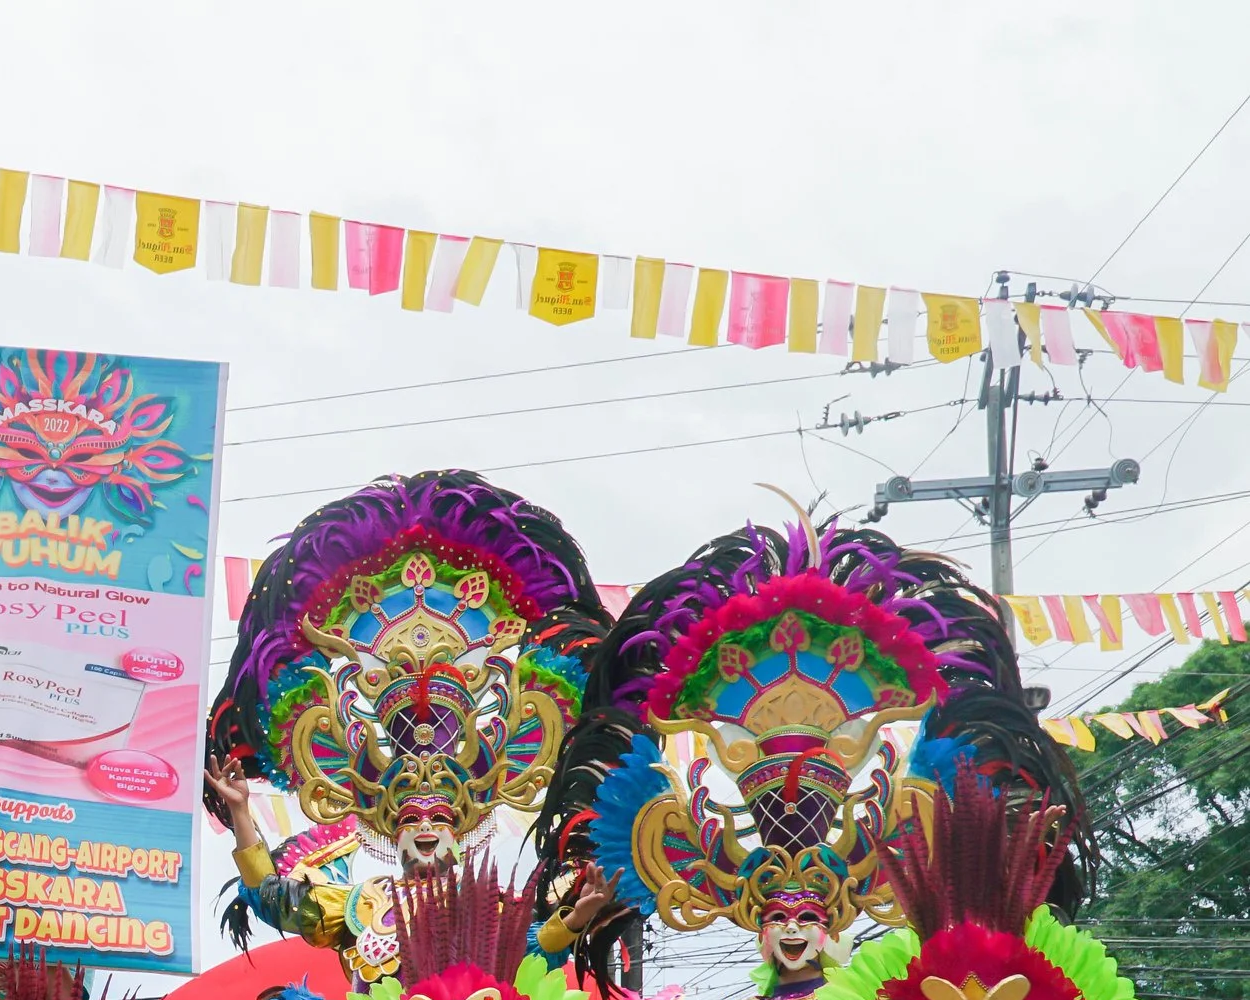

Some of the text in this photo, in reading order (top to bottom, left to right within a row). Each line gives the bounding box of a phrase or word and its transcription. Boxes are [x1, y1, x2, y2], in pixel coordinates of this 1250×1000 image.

[44, 417, 70, 433] 2022
[7, 581, 29, 591] to
[34, 581, 100, 599] Natural
[105, 590, 150, 605] Glow
[54, 603, 128, 627] Peel
[65, 622, 130, 639] PLUS
[133, 653, 178, 668] 100mg
[131, 666, 177, 678] Collagen
[2, 670, 83, 698] RosyPeel
[49, 692, 81, 706] PLUS
[99, 764, 170, 779] Guava Extract
[108, 773, 146, 784] Kamias
[116, 782, 151, 793] Bignay
[14, 908, 174, 955] DANCING
